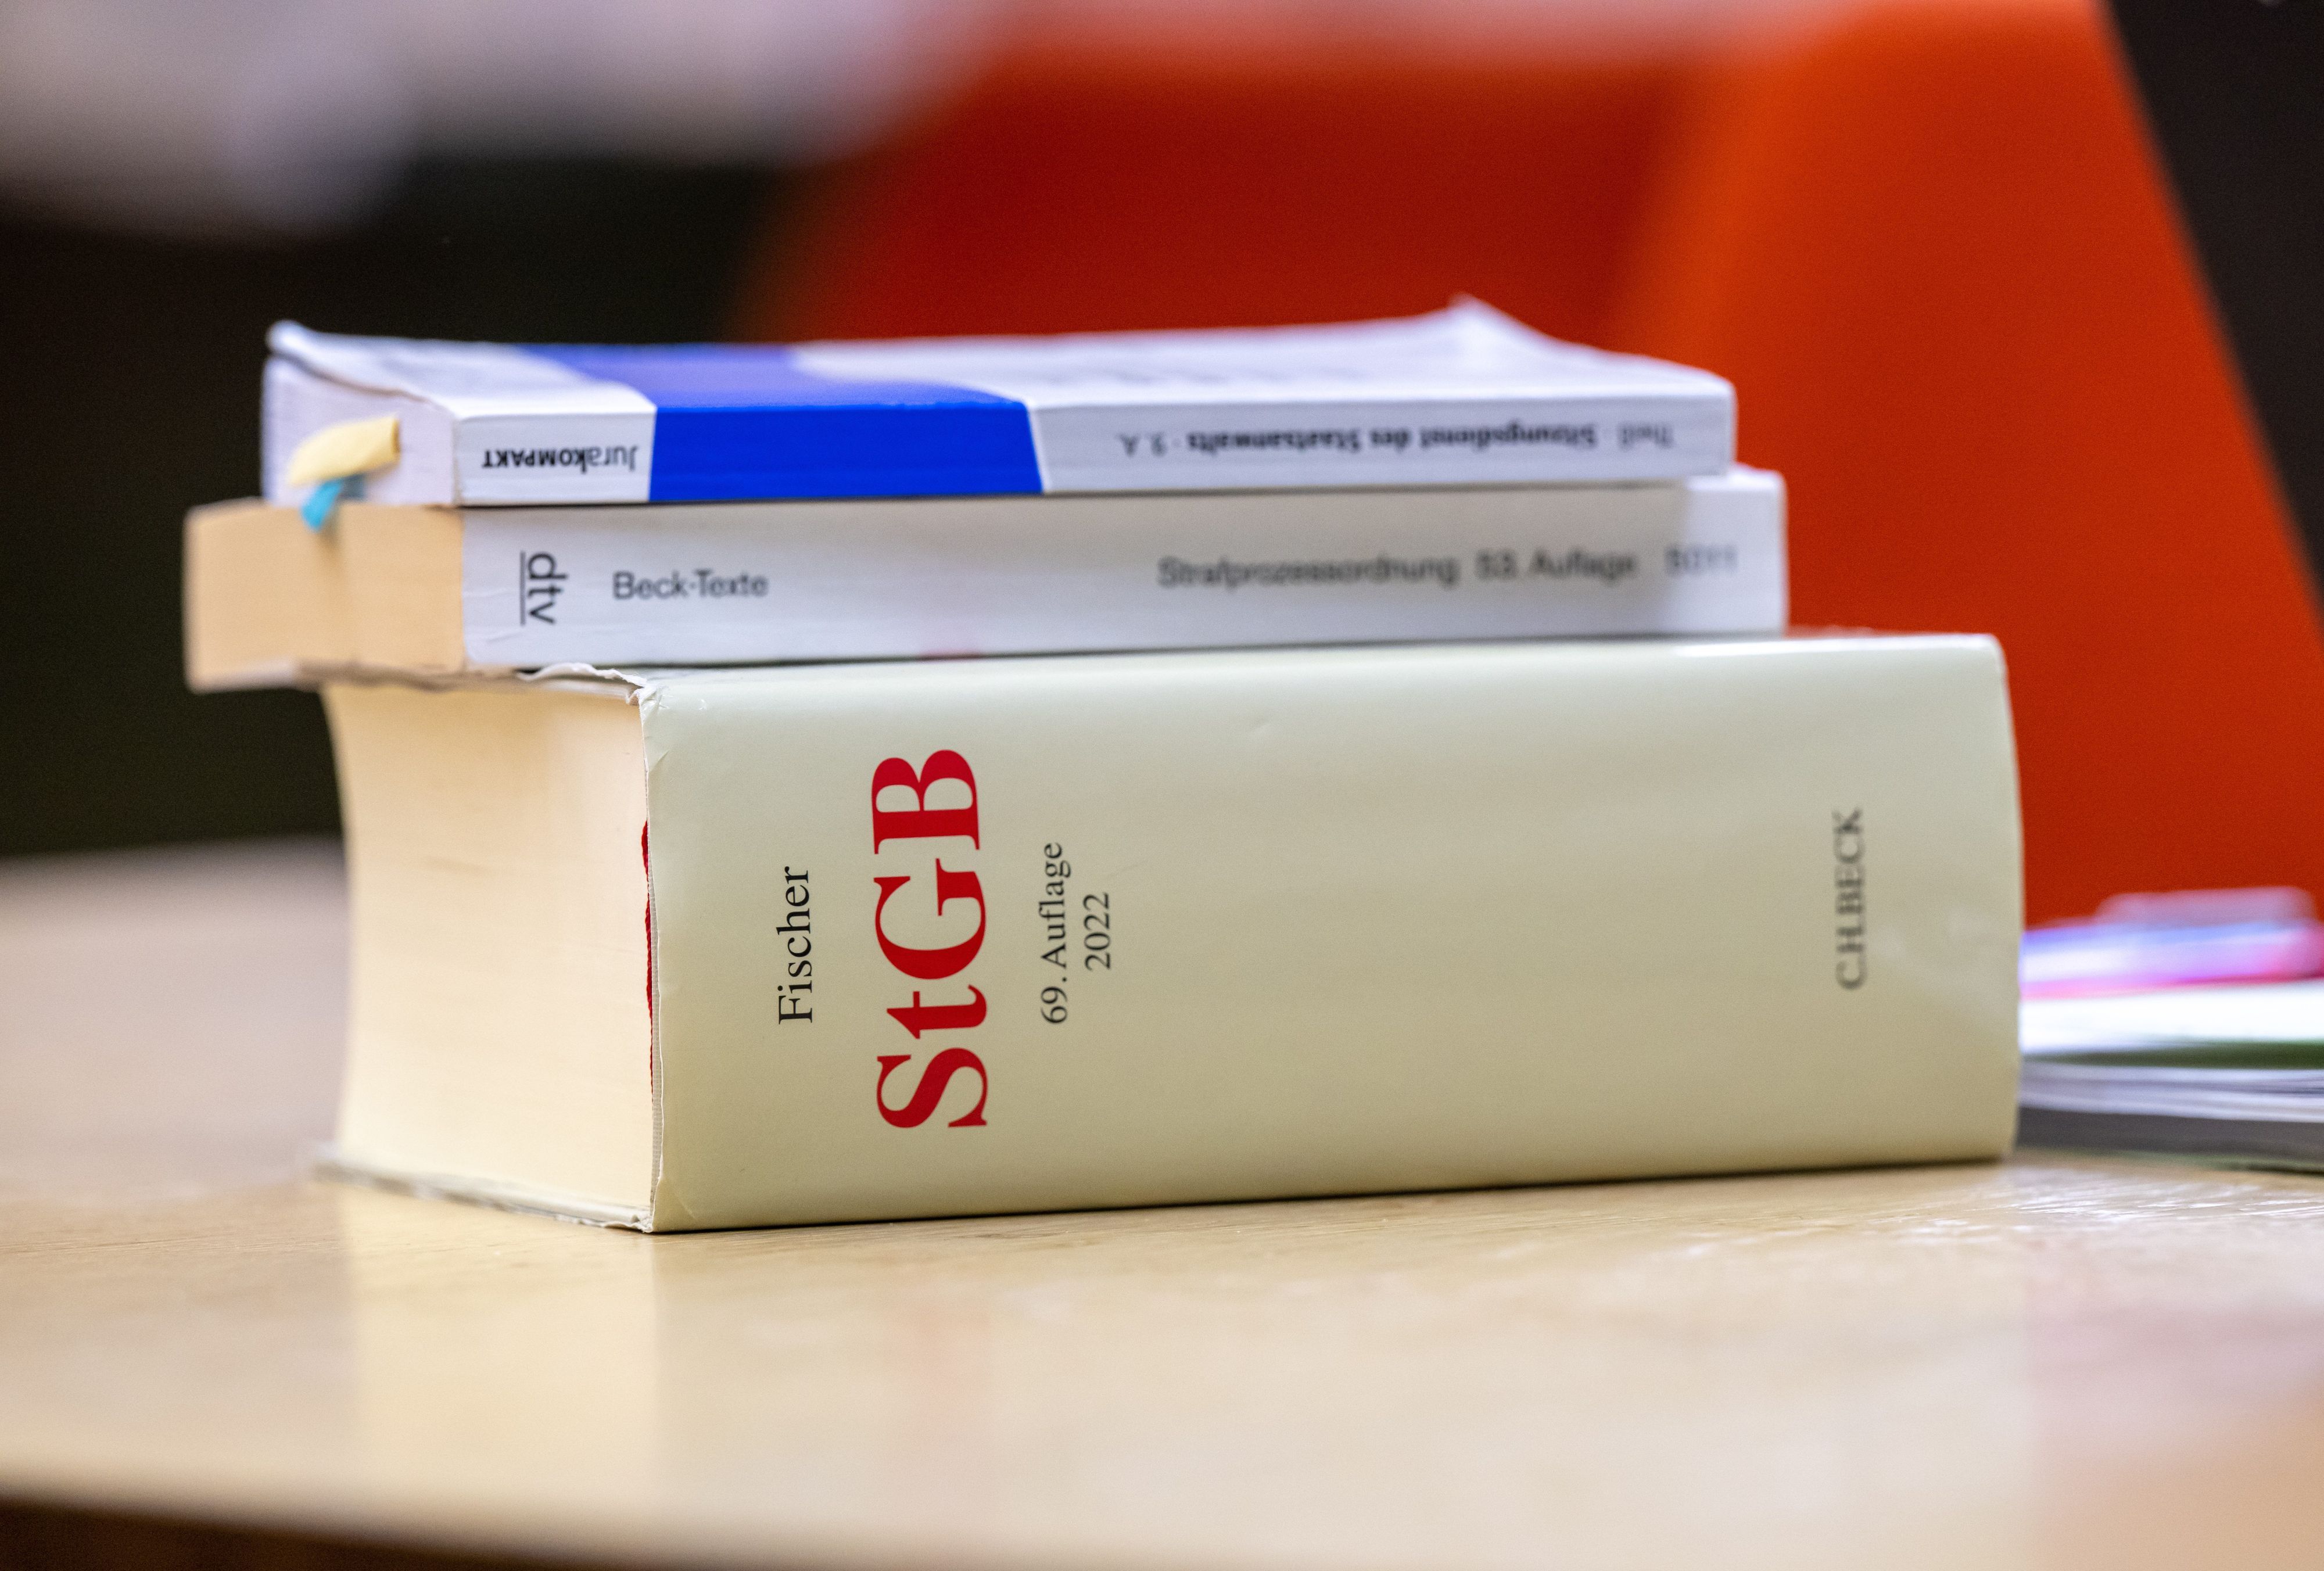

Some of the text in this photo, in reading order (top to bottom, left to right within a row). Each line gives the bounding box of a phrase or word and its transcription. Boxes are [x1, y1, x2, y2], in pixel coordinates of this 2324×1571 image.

[1185, 428, 1361, 455] Staatsanwalts
[1369, 427, 1412, 455] des
[1418, 418, 1598, 451] Sitzungsdienst
[526, 551, 568, 625] dtv
[1157, 552, 1459, 593] Strafprozessordnung
[1526, 546, 1637, 588] Auflage
[776, 866, 813, 1025] Fischer
[871, 749, 988, 1129] StGB
[1038, 841, 1072, 1025] 69. Auflage
[1082, 891, 1111, 972] 2022
